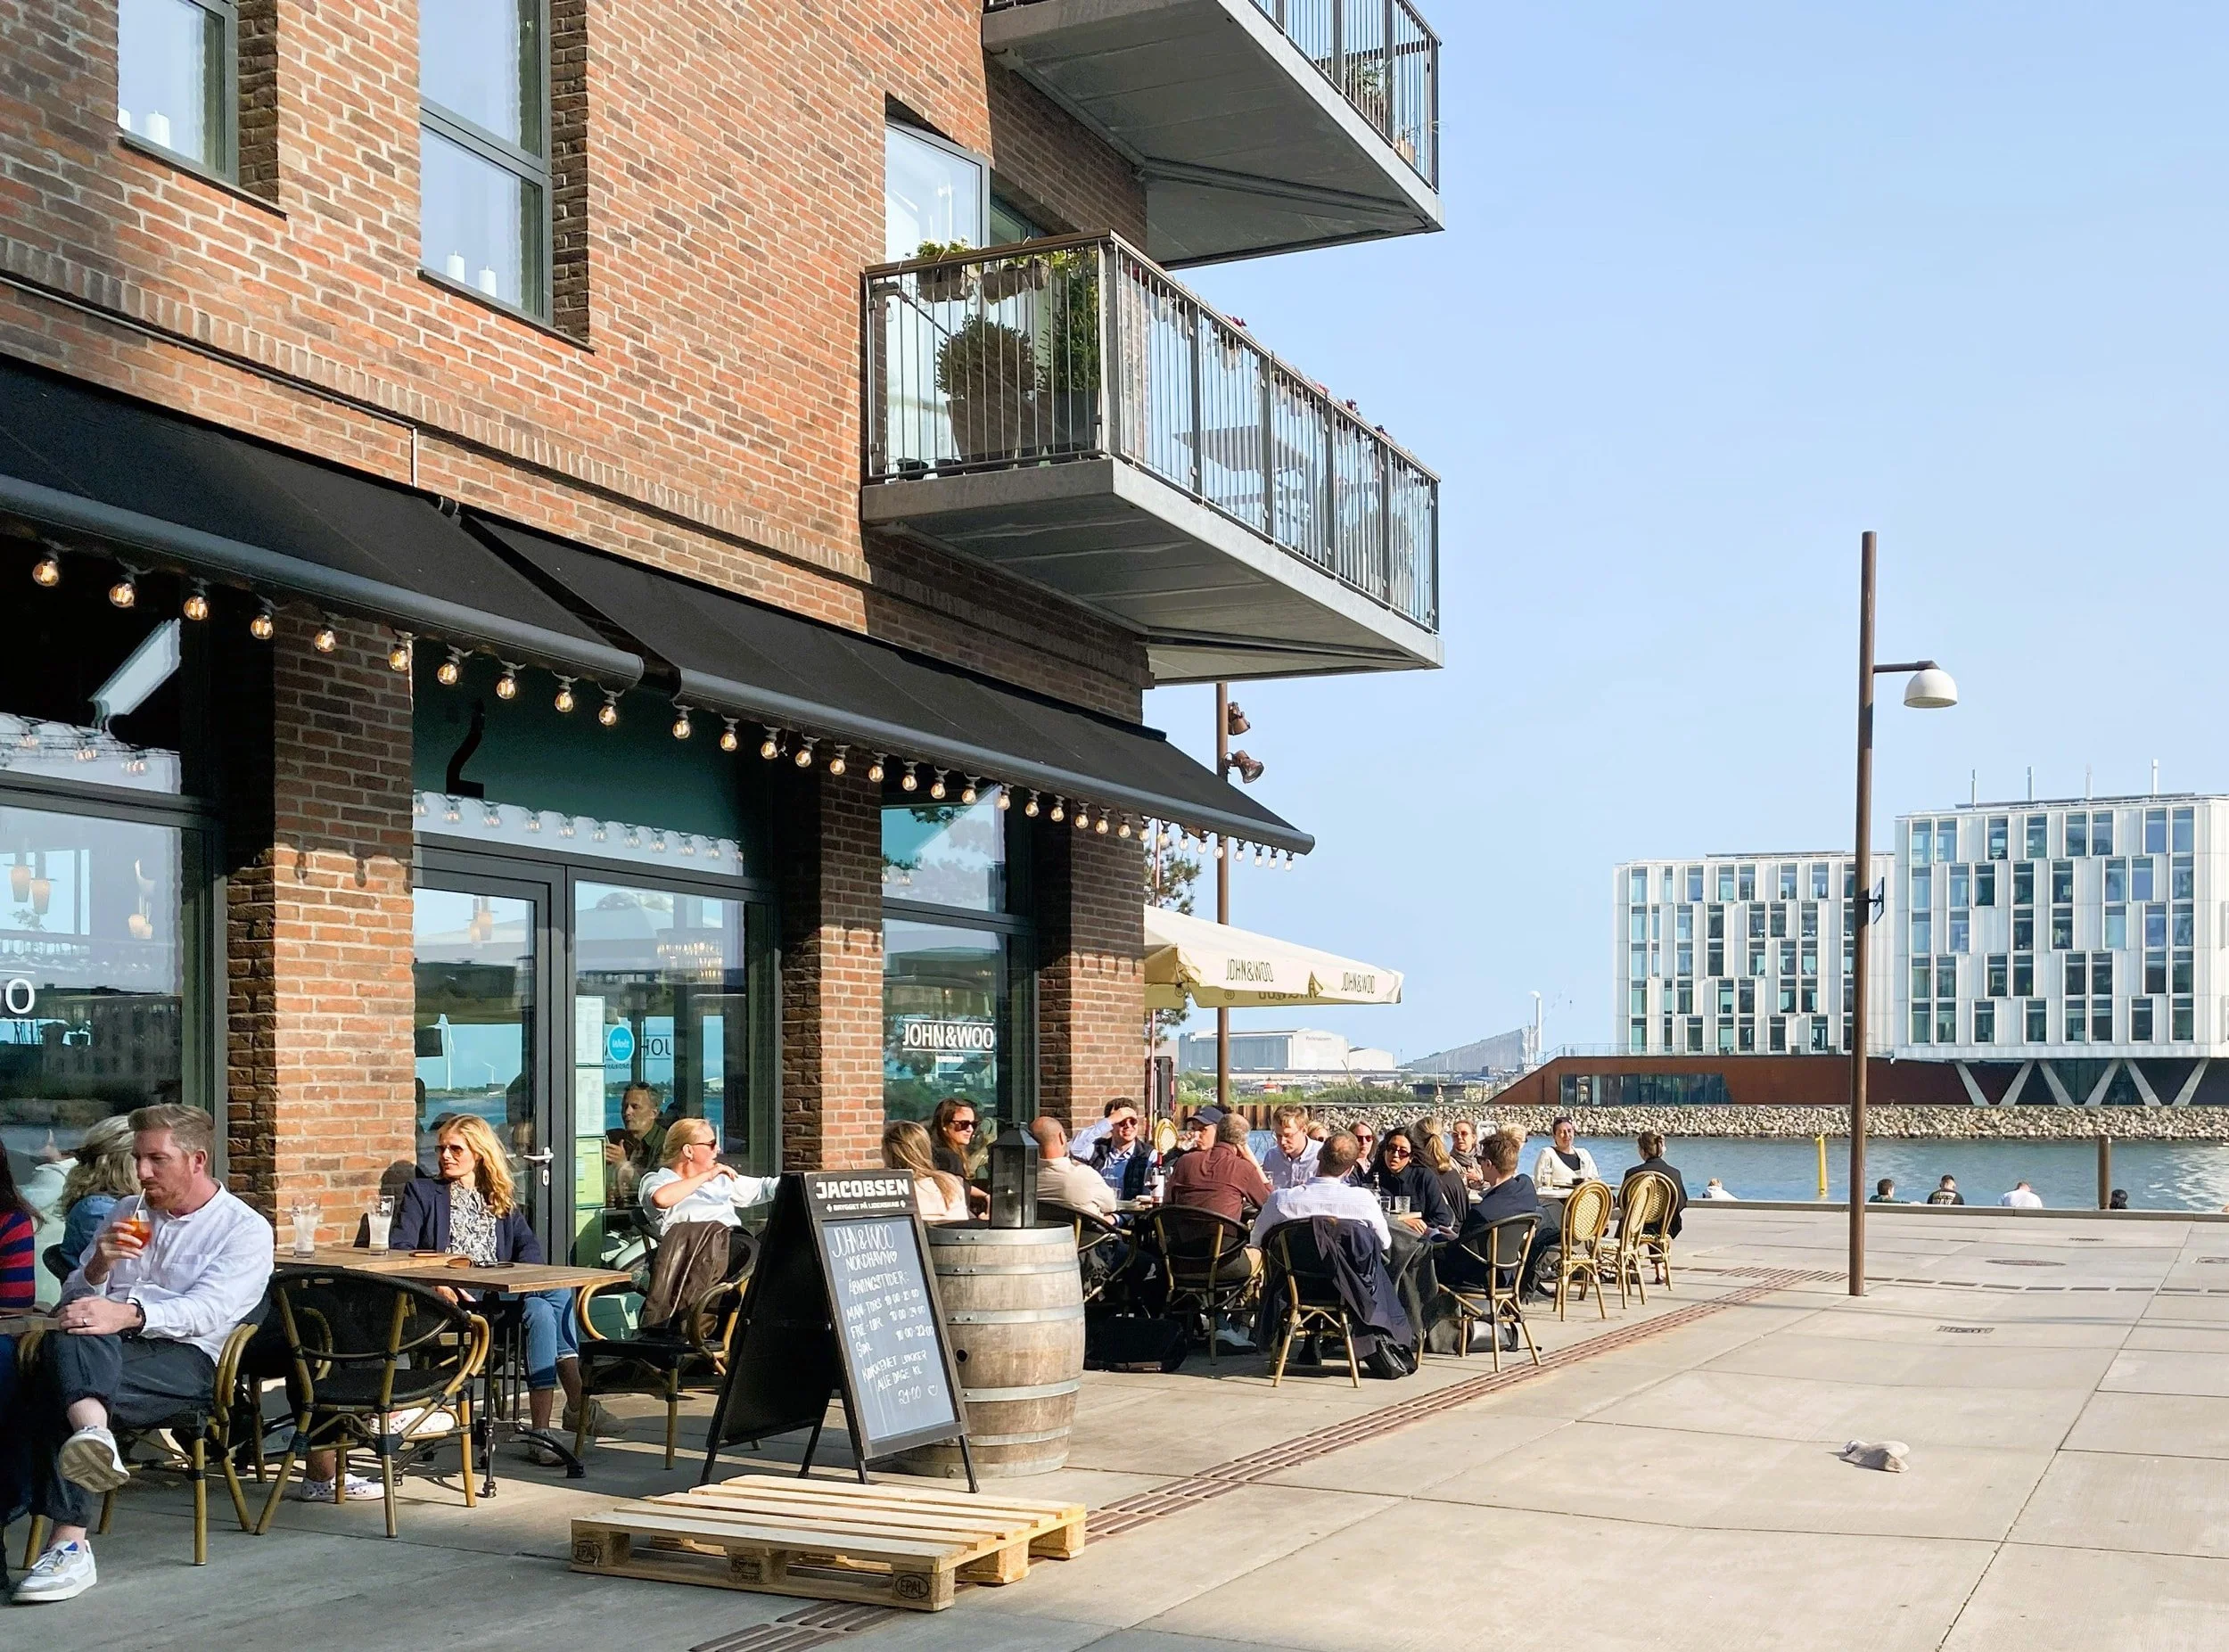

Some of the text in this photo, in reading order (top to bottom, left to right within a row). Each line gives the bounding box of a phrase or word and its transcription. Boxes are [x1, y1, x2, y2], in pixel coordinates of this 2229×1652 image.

[1226, 958, 1274, 982] JOHN&WOO
[1341, 971, 1376, 994] JOHN&WOO
[902, 1023, 994, 1049] JOHN&WOO
[816, 1179, 909, 1200] JACOBSEN
[832, 1224, 895, 1258] JOHN&WOO
[845, 1251, 892, 1272] NORDHAVN
[901, 1579, 925, 1595] EPAL
